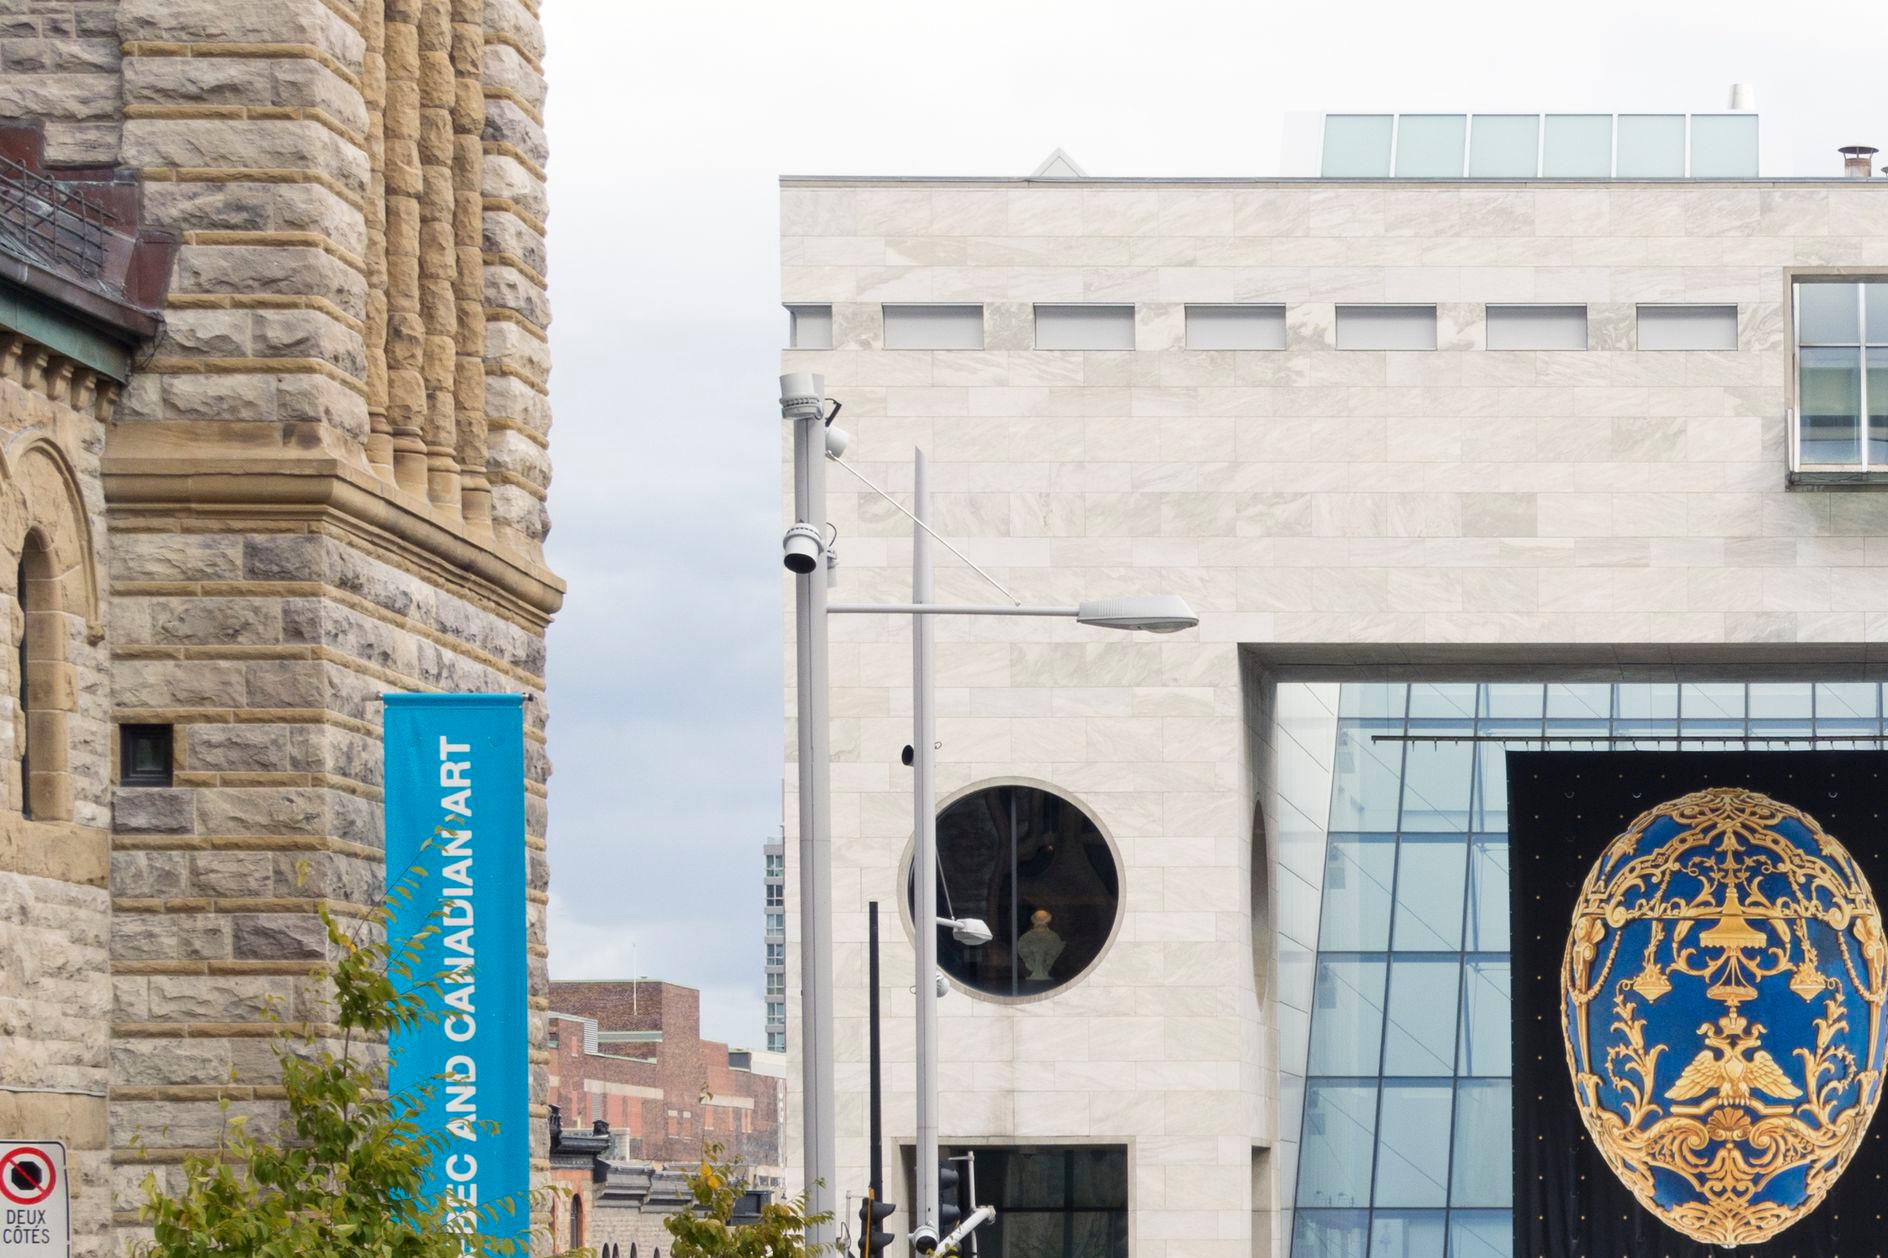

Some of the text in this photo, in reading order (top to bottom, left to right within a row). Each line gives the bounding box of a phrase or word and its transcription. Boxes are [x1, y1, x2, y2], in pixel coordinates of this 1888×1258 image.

[439, 735, 472, 817] ART
[441, 829, 477, 1041] CANADIAN
[445, 1055, 477, 1142] AND
[2, 1225, 51, 1244] CÔTÉS
[6, 1209, 46, 1225] DEUX
